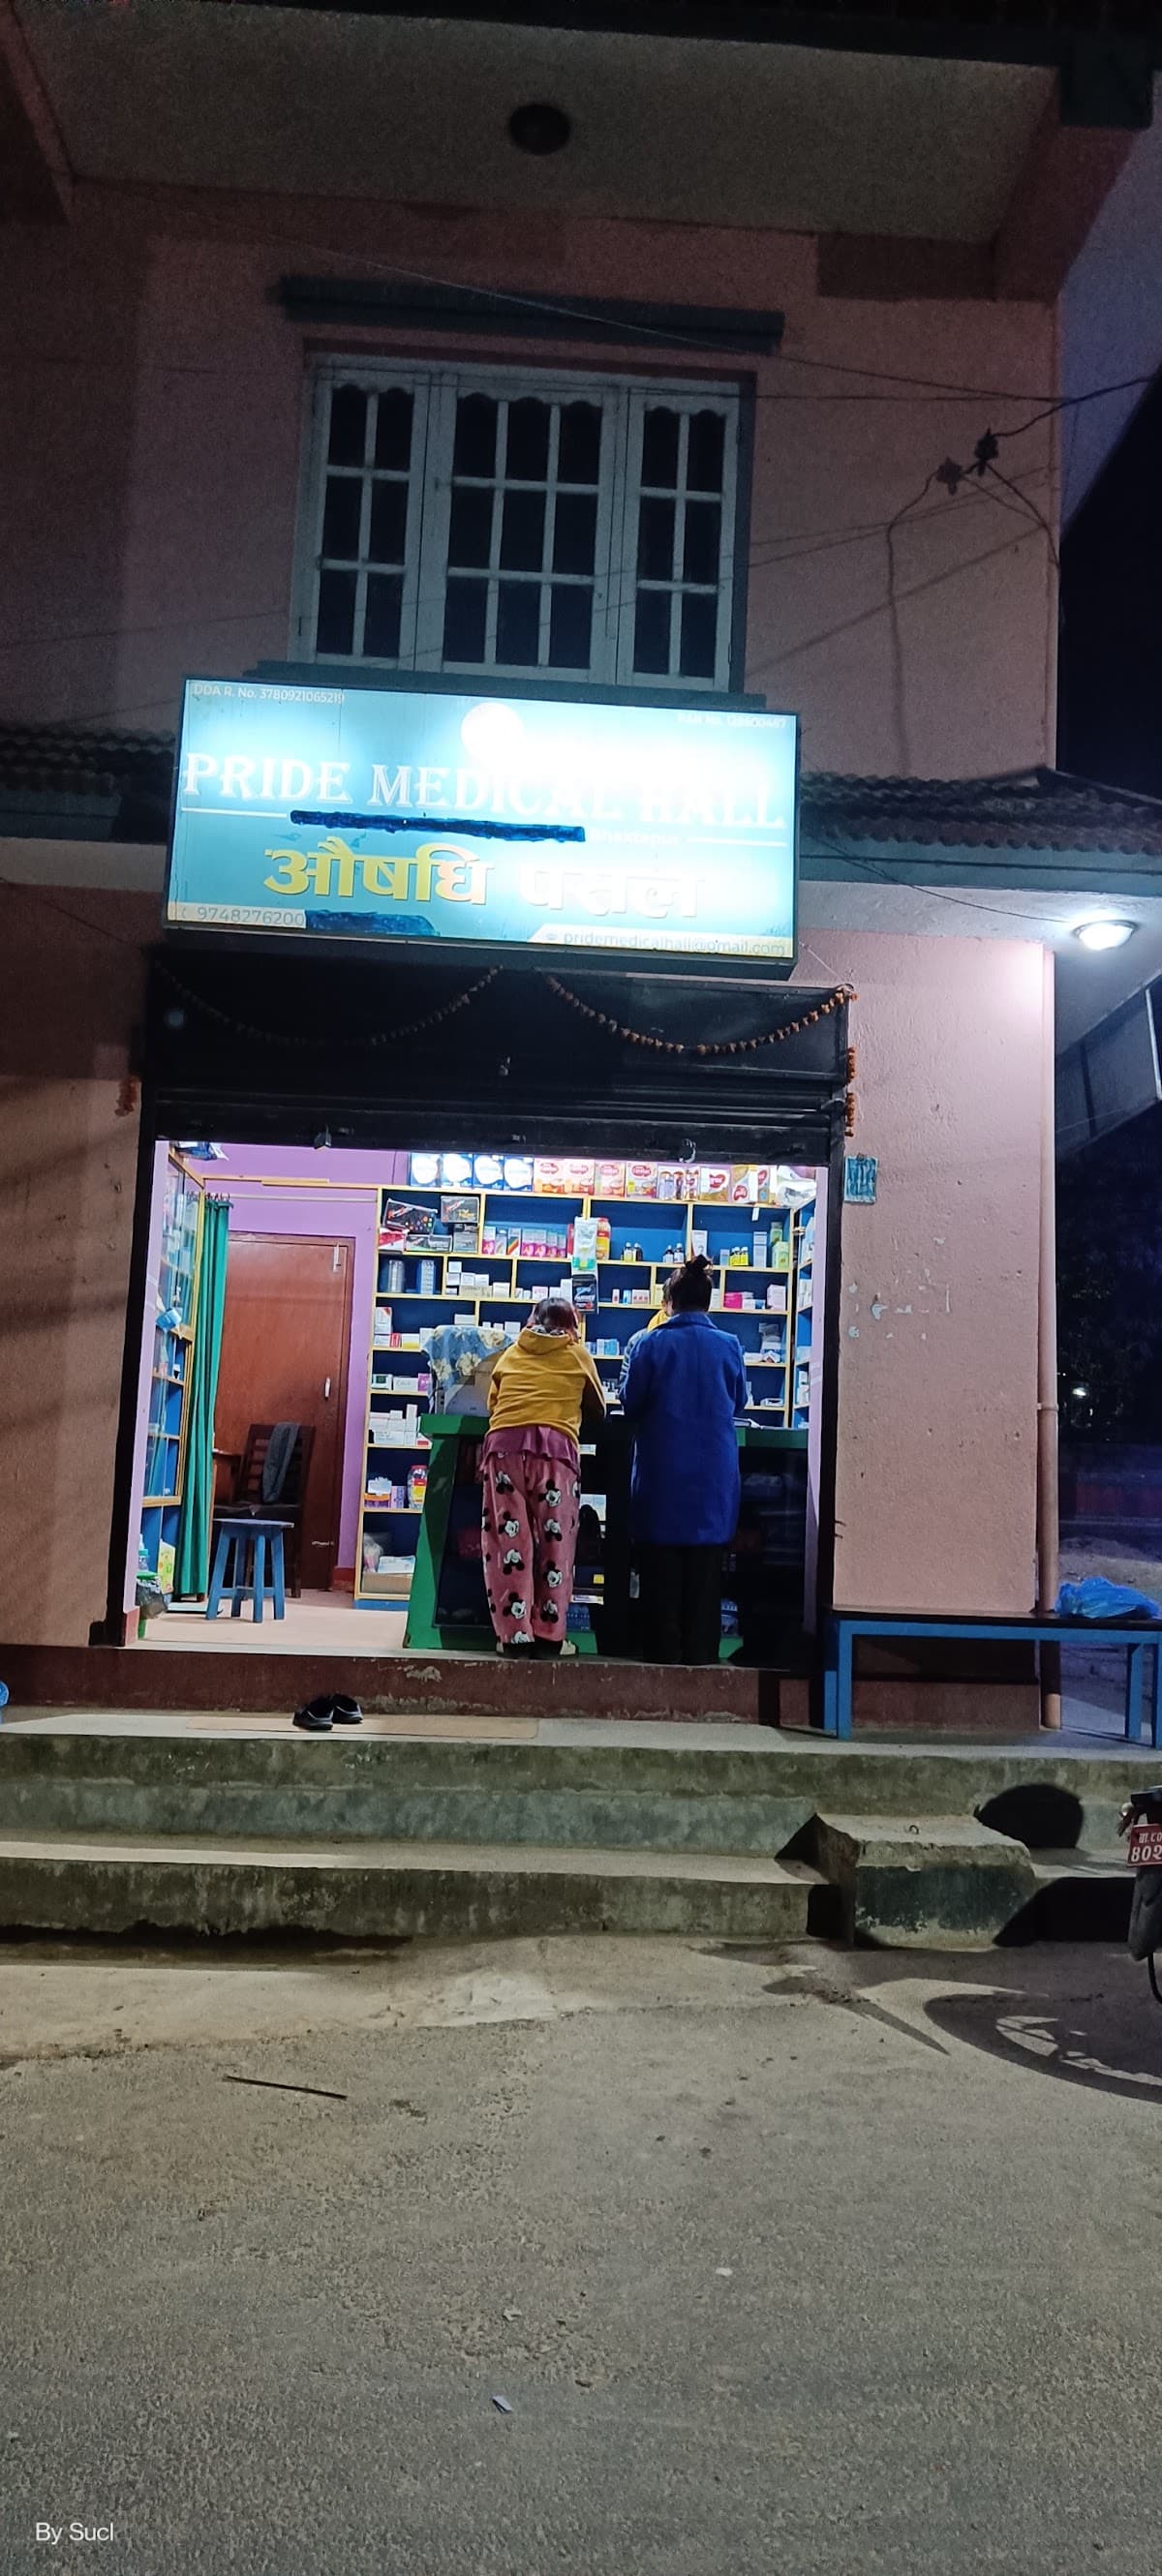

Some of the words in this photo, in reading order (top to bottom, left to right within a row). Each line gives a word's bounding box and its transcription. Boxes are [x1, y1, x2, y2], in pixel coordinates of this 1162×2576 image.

[194, 683, 221, 697] DDA
[224, 686, 234, 697] R.
[238, 687, 257, 698] No.
[184, 752, 351, 803] PRIDE
[368, 765, 620, 819] MEDICAL
[637, 779, 786, 829] HALL
[262, 835, 496, 906] औषधि
[197, 906, 305, 926] 9748276200
